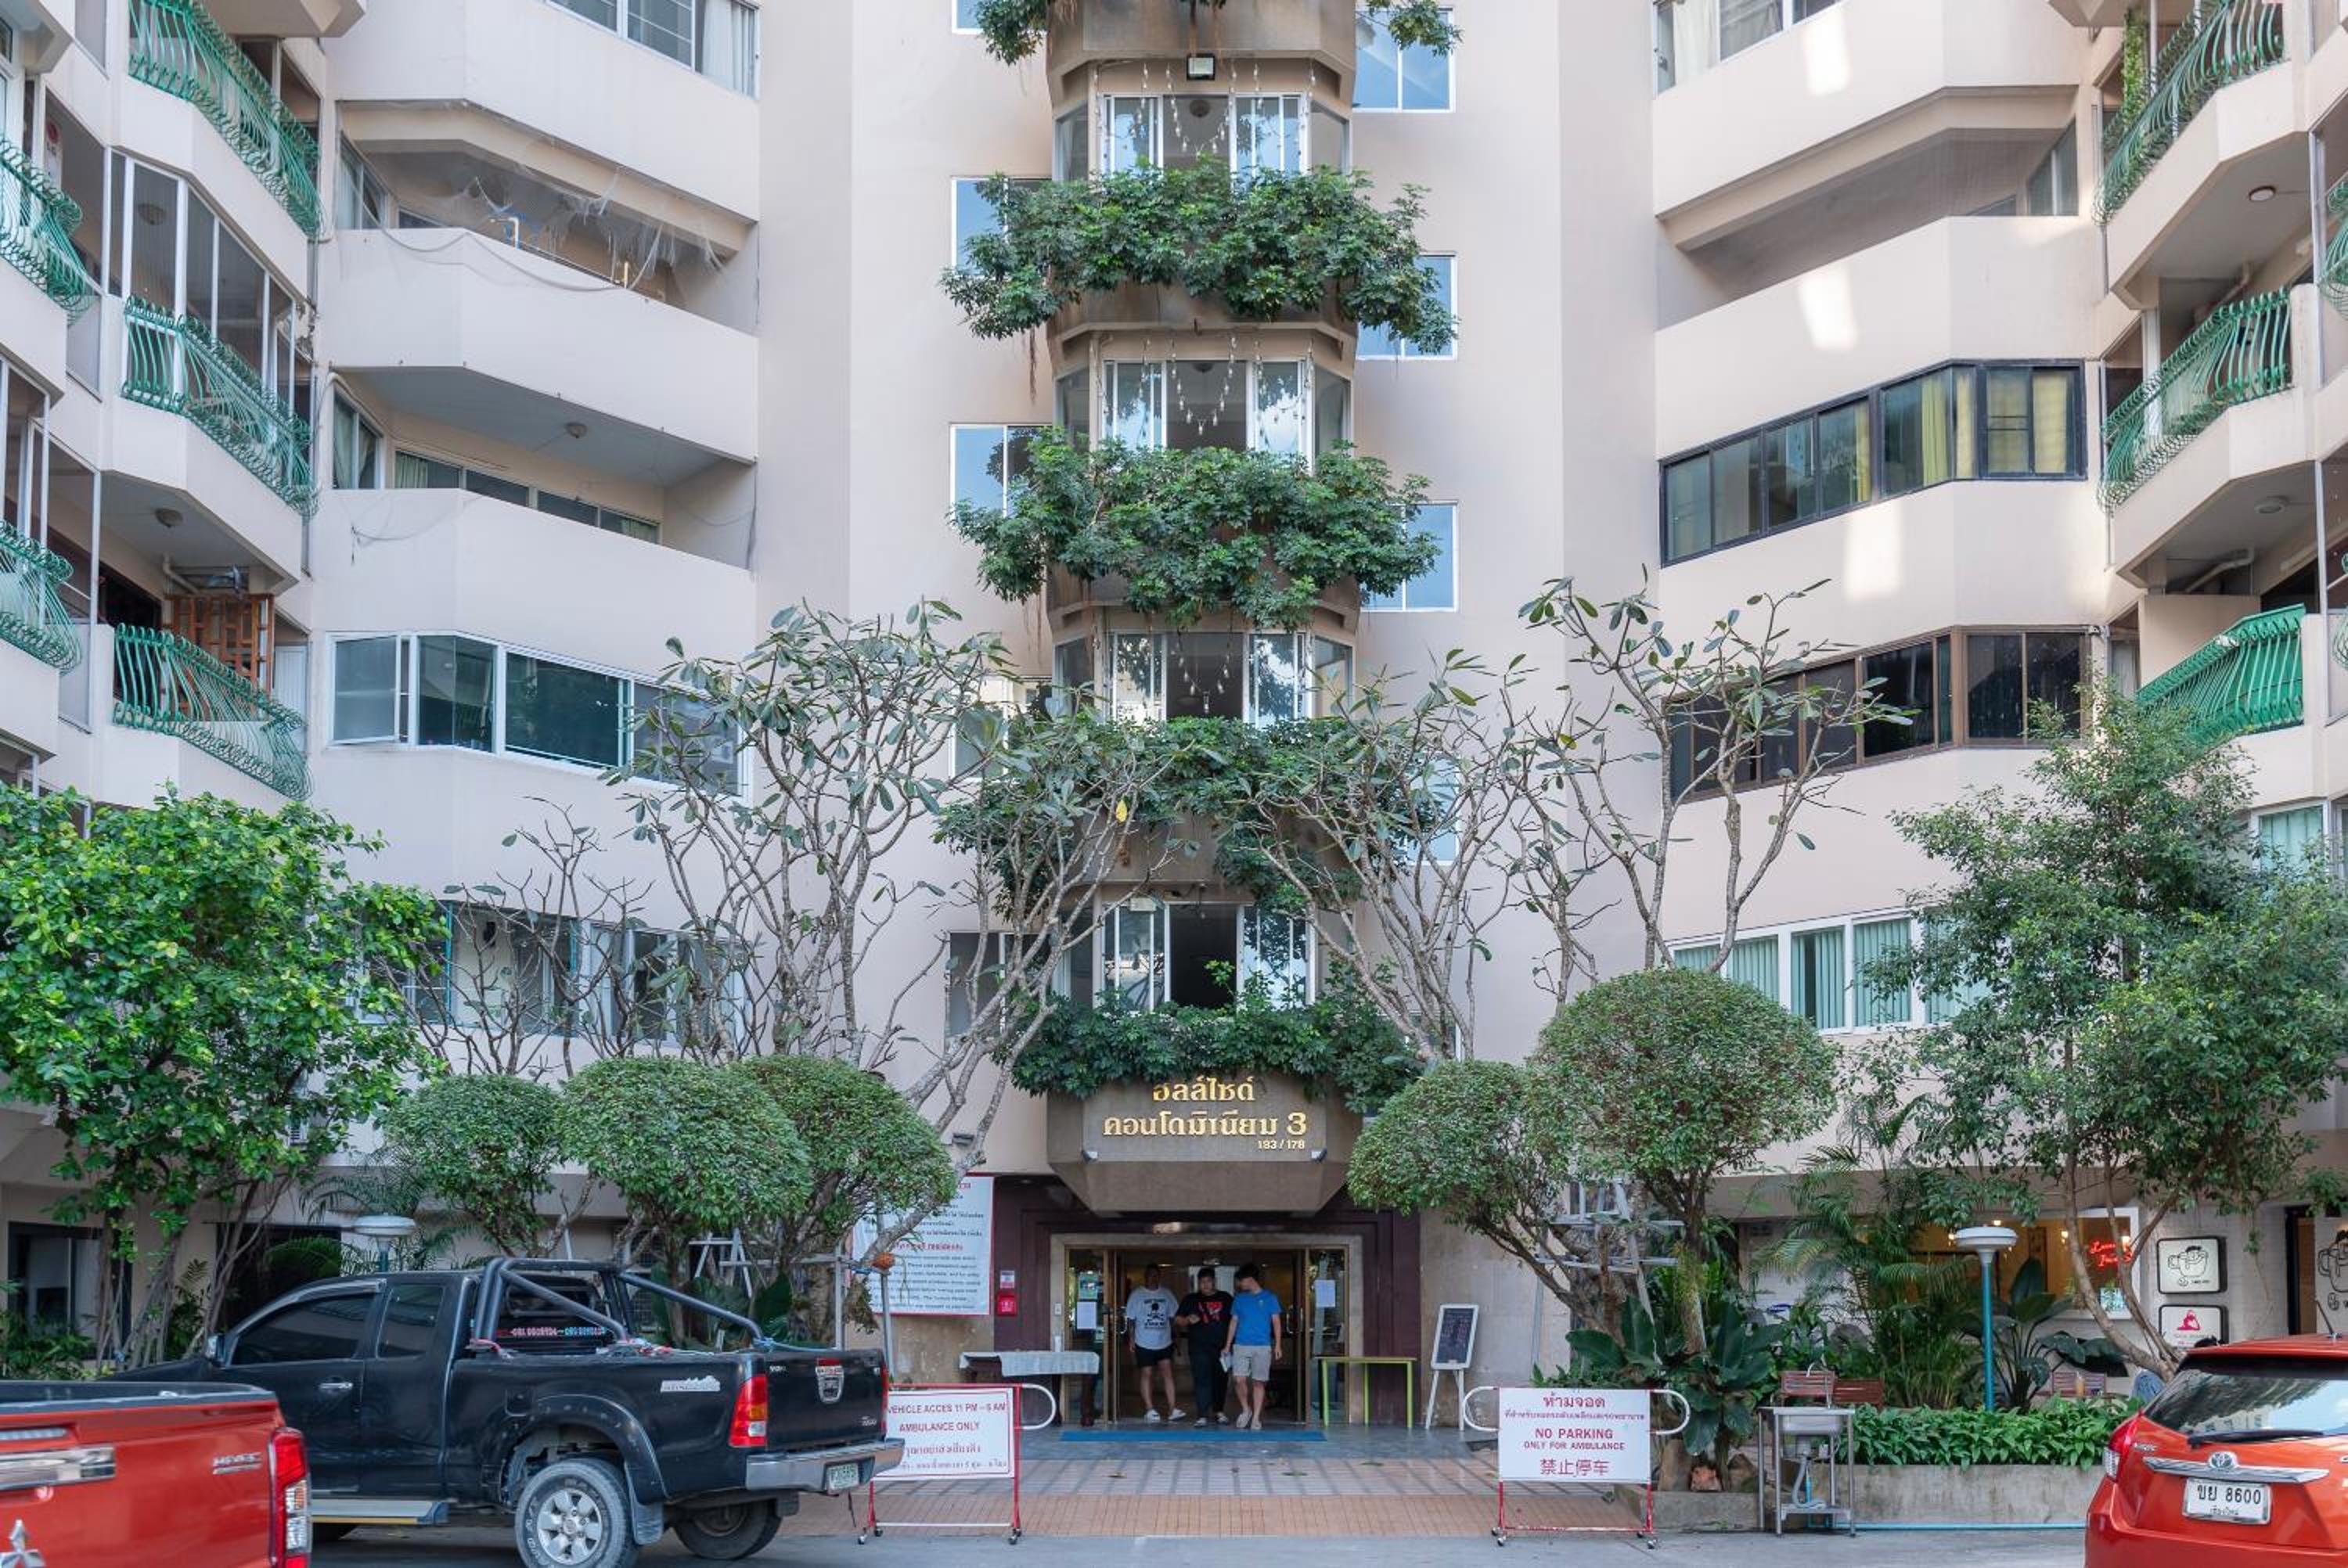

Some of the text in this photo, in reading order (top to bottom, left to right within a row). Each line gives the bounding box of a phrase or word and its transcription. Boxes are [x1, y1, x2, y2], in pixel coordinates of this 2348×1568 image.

[1287, 1111, 1307, 1136] 3
[1543, 1391, 1606, 1408] ห้ามจอด
[899, 1421, 979, 1432] AMBULANCE ONLY
[1535, 1428, 1613, 1439] NO PARKING
[1524, 1440, 1626, 1451] ONLY FOR AMBULANCE
[1540, 1458, 1610, 1477] 禁止停车
[2225, 1487, 2261, 1504] 8600
